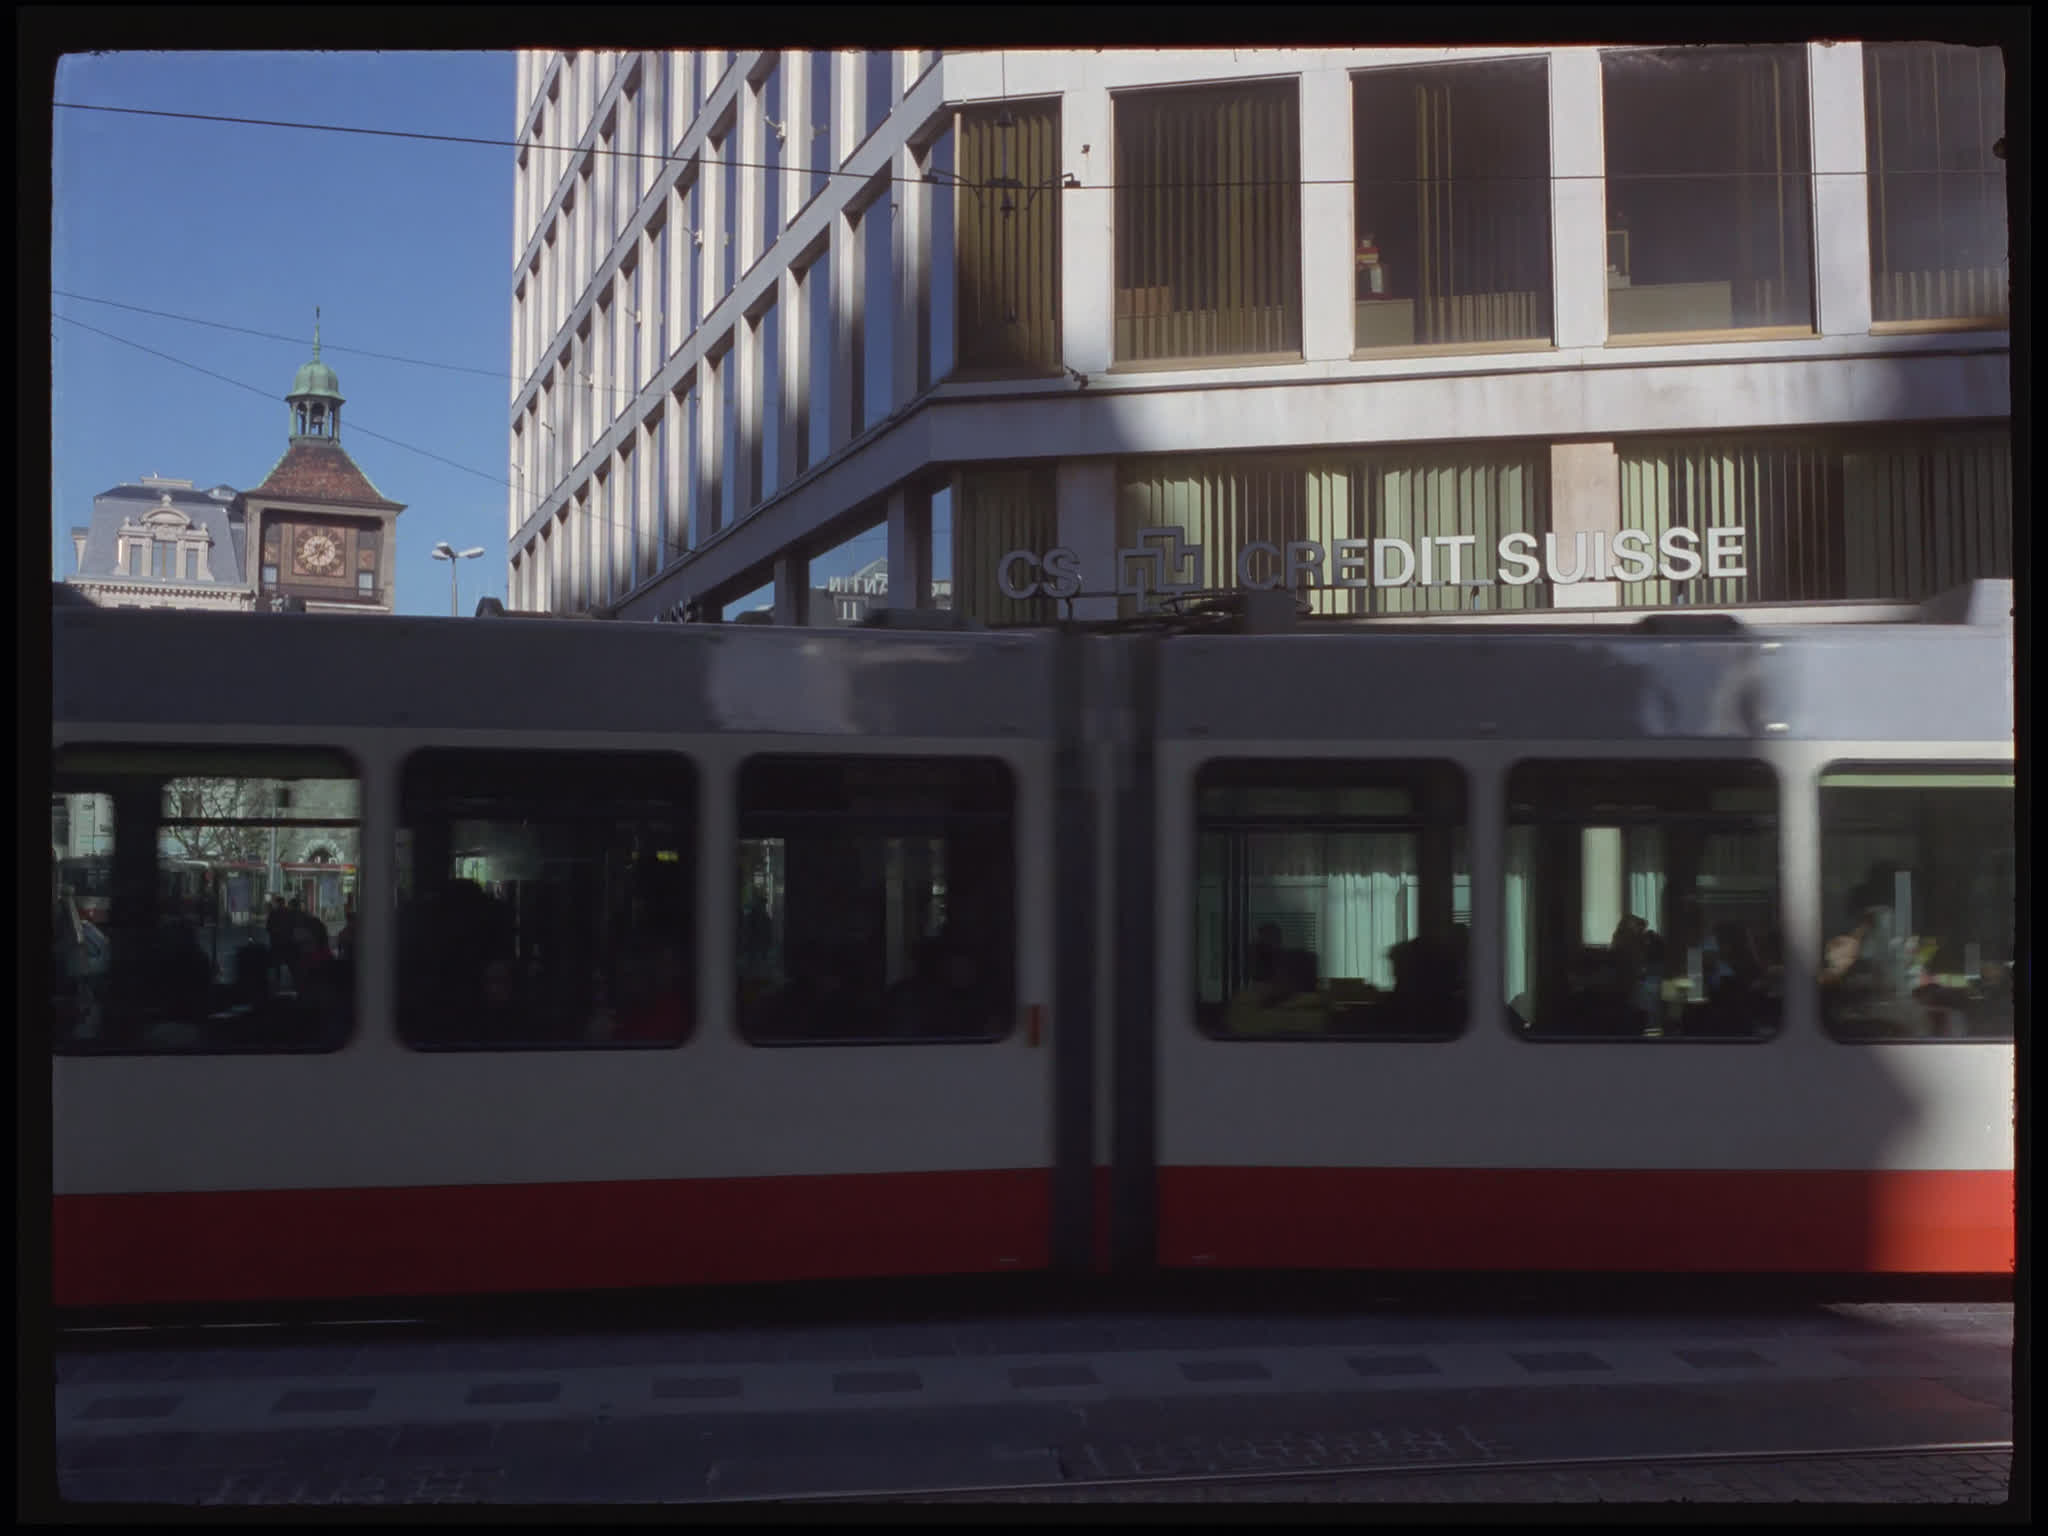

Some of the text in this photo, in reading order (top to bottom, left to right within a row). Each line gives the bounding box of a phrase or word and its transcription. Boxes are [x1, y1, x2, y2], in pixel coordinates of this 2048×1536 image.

[997, 526, 1747, 600] CS CREDIT SUISSE
